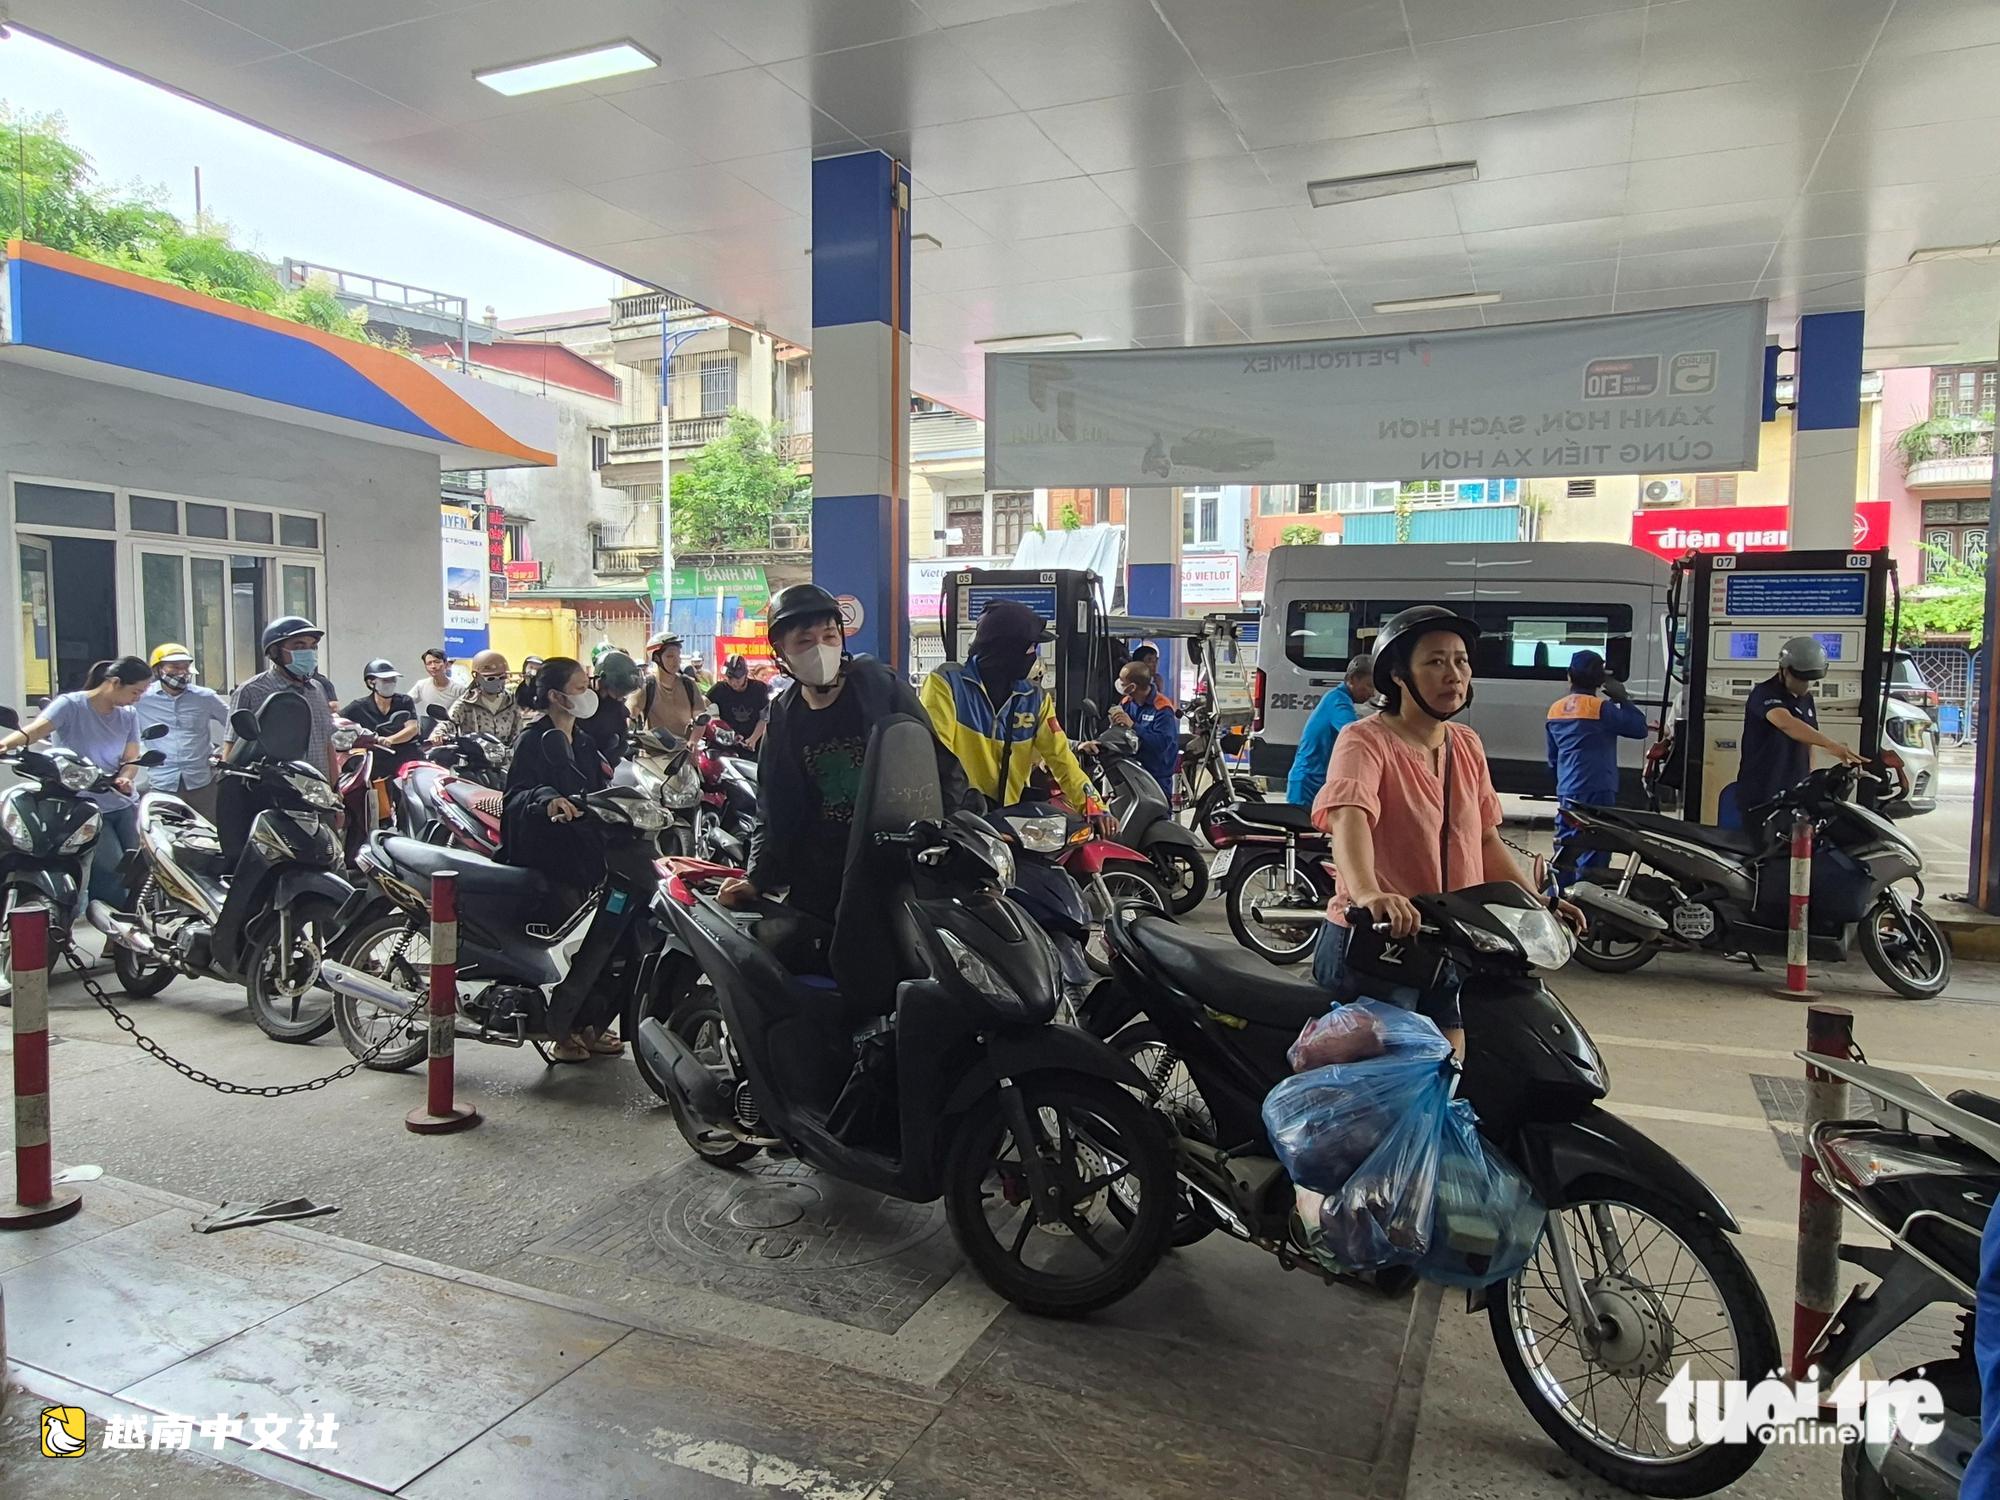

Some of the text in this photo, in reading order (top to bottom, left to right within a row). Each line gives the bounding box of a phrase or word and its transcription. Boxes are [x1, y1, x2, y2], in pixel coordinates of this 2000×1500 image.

[1715, 557, 1733, 568] 07
[1849, 555, 1867, 566] 08
[958, 574, 970, 583] 05
[1042, 573, 1054, 582] 06
[1194, 570, 1231, 581] VIETLOT
